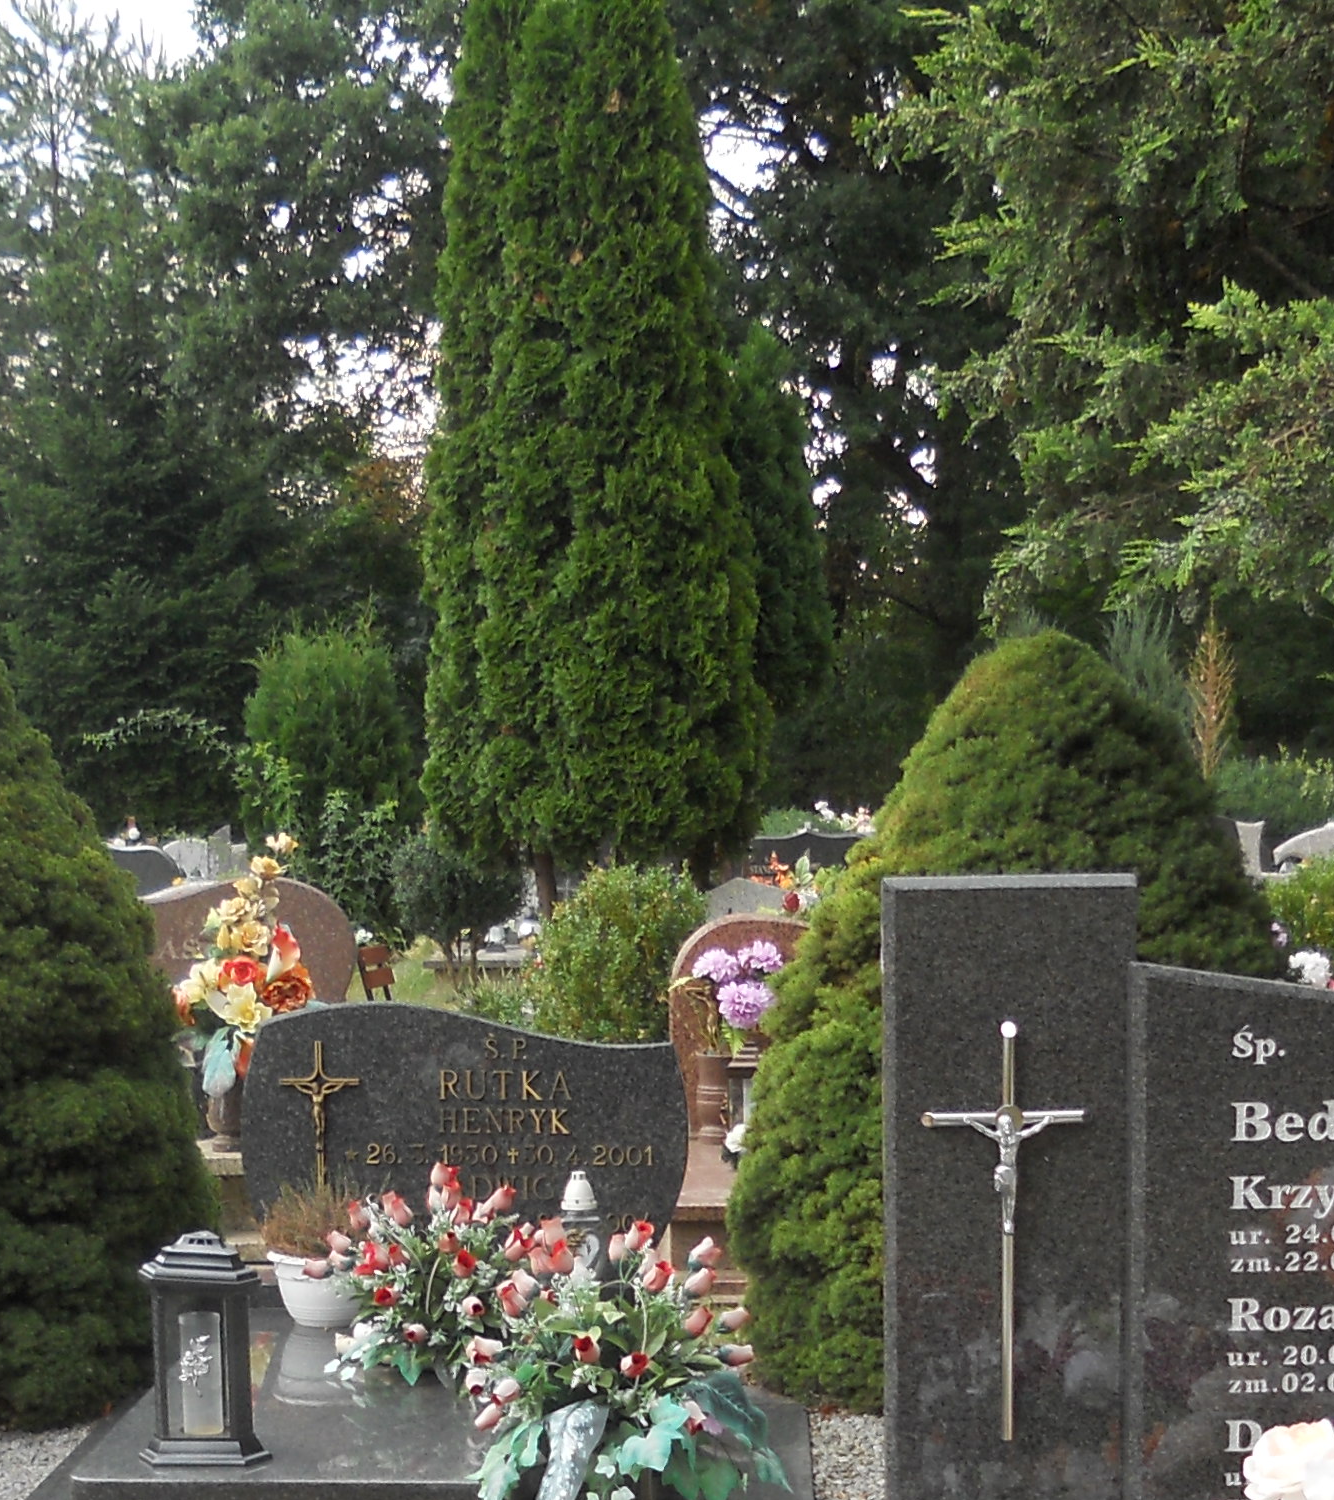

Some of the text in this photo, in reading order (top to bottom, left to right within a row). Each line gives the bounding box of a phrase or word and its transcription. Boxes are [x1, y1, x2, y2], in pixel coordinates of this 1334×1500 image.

[1231, 1024, 1286, 1065] Śp.
[438, 1070, 572, 1100] RUTKA
[438, 1108, 571, 1135] HENRYK
[1228, 1230, 1271, 1247] ur.
[1227, 1351, 1269, 1368] ur.
